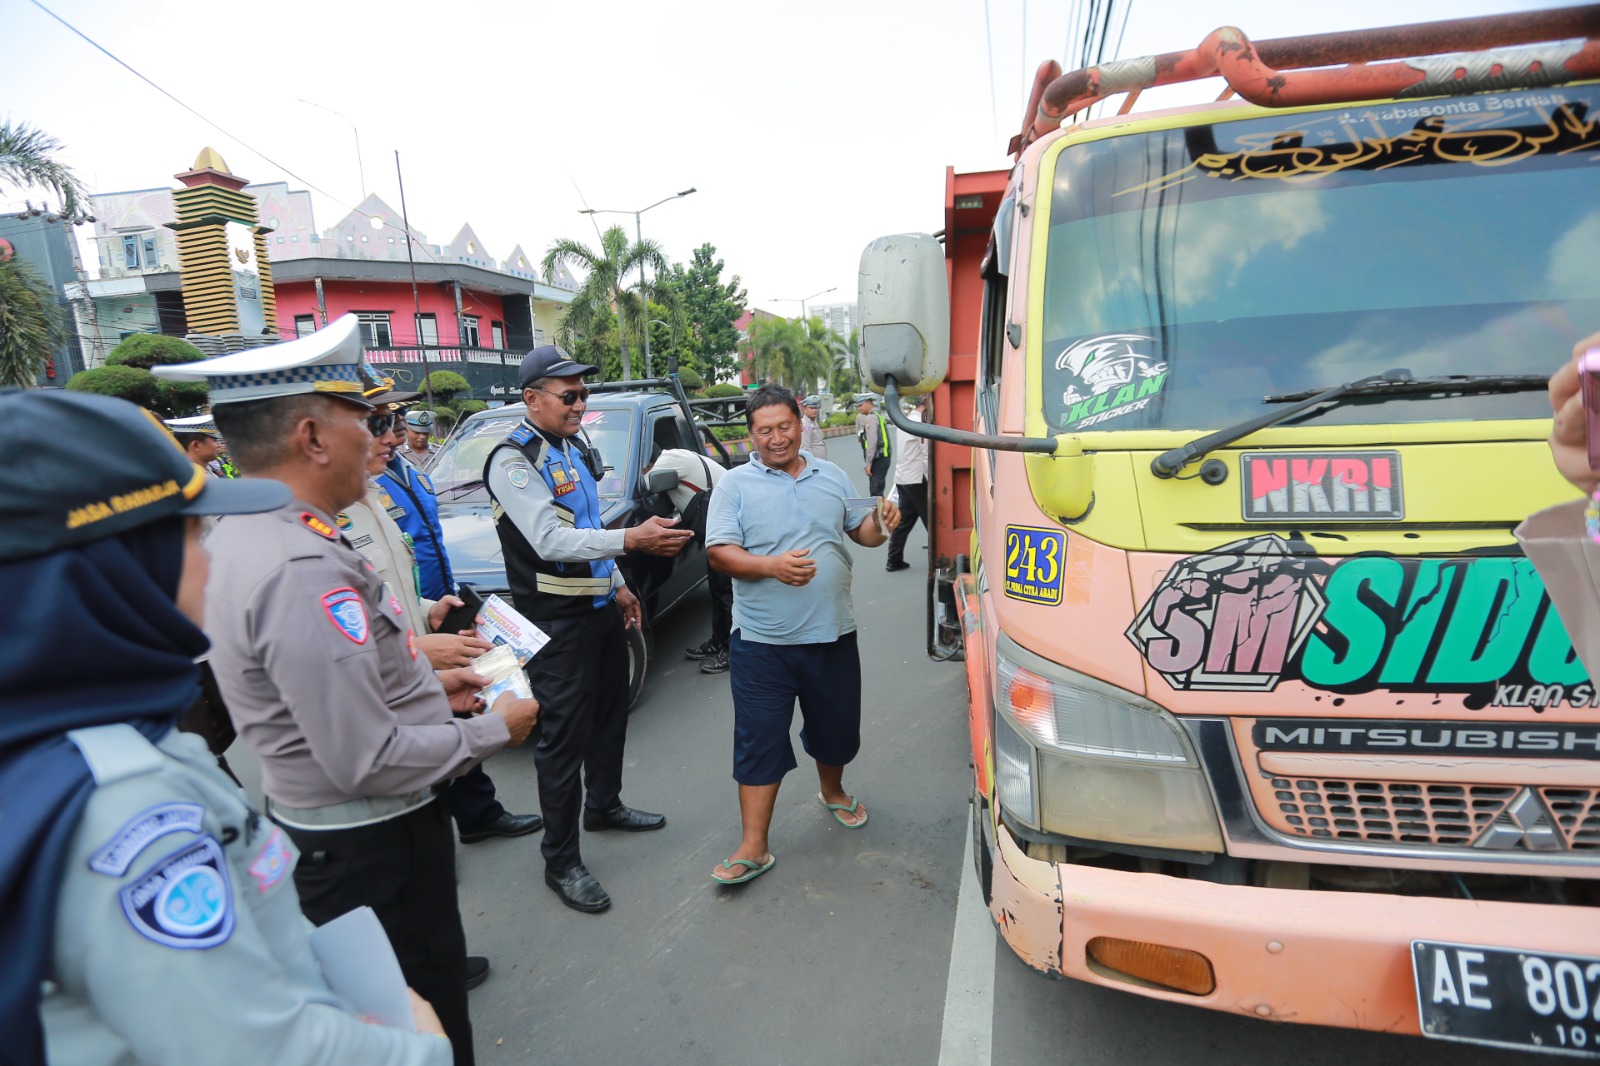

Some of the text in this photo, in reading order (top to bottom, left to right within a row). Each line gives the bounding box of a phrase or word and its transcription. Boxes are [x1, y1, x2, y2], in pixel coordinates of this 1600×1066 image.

[1063, 372, 1168, 425] KLAN
[1077, 398, 1150, 430] STICKER
[1250, 457, 1393, 513] NKRI
[66, 501, 114, 529] JASA
[1007, 532, 1059, 584] 243
[1147, 568, 1303, 673] SM
[1492, 684, 1564, 706] KLAN
[1433, 949, 1493, 1010] AE
